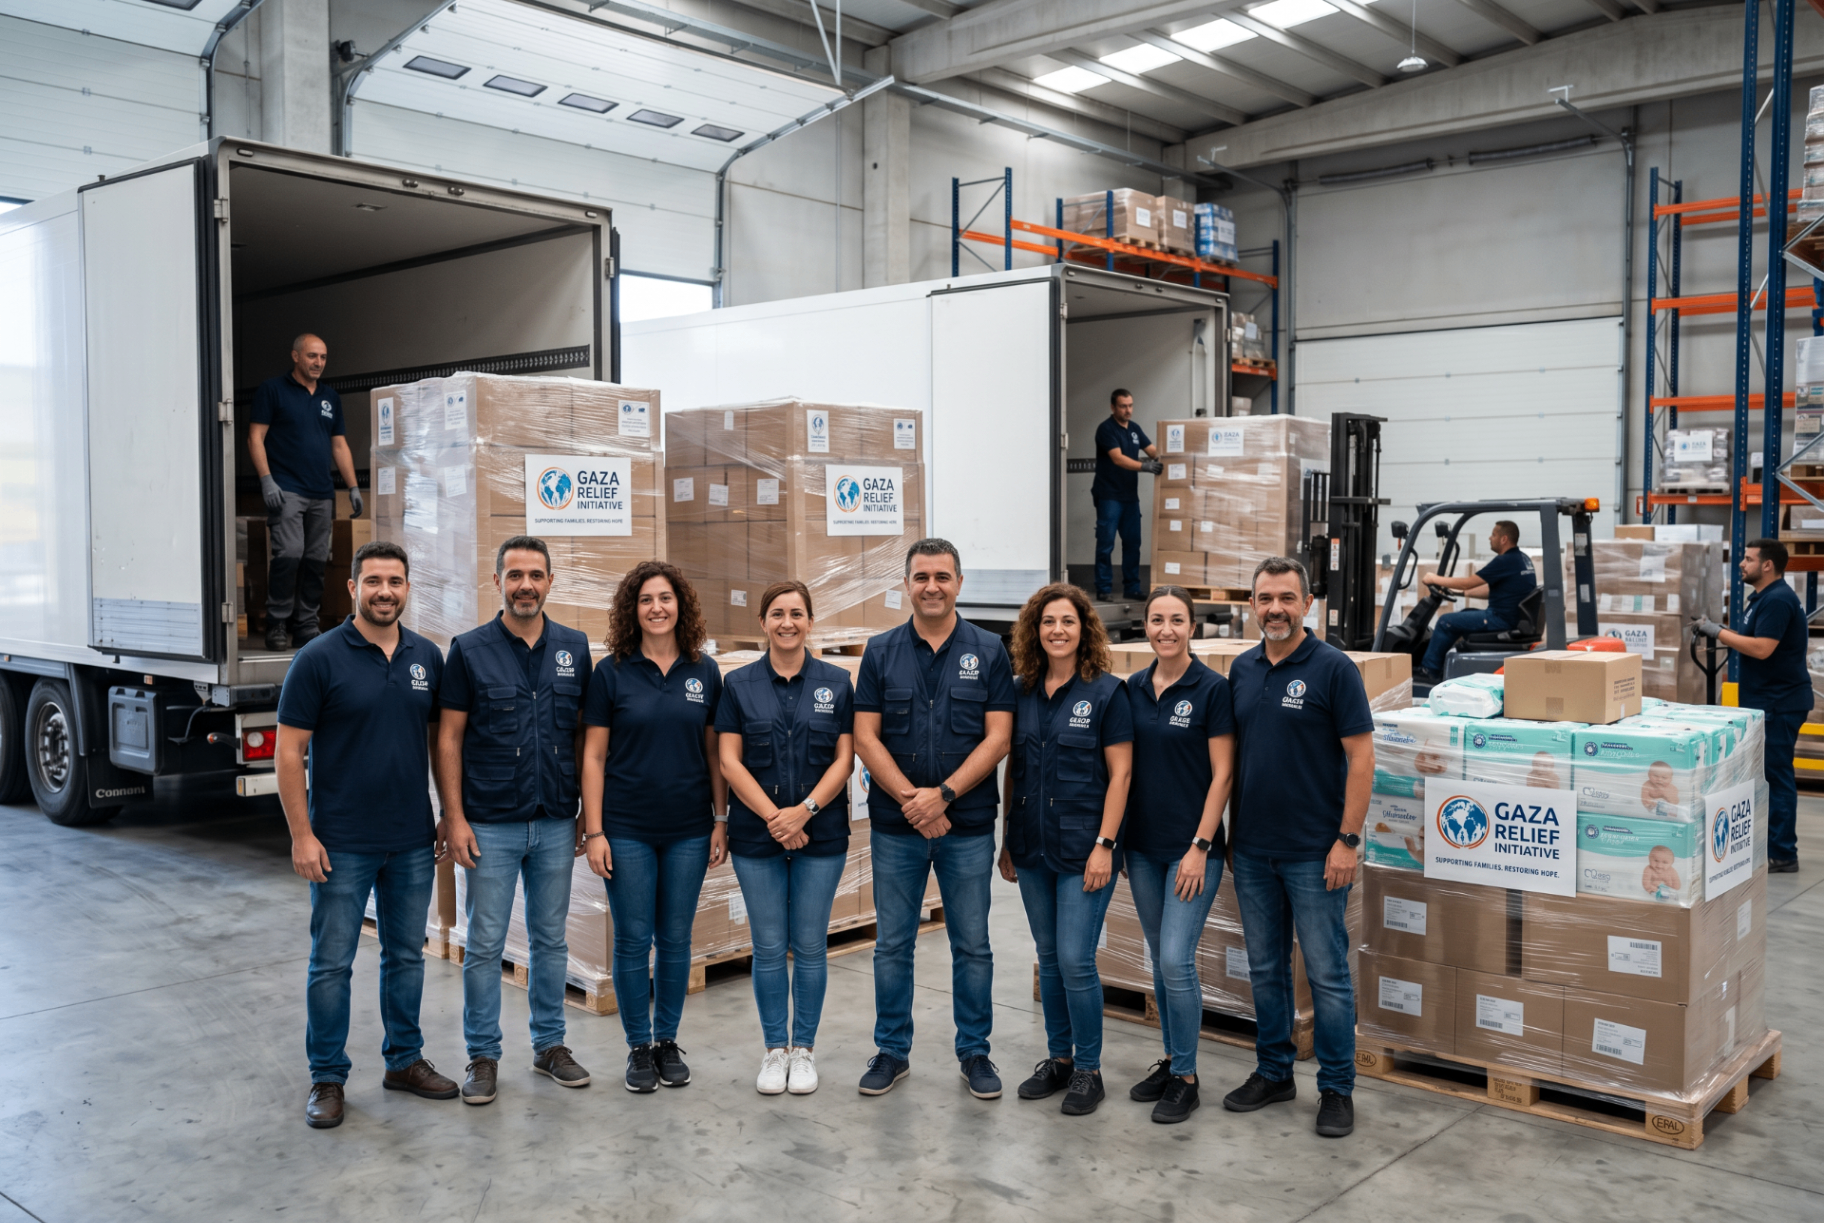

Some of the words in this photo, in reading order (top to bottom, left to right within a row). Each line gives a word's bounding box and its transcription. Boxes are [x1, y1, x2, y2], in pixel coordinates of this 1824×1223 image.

[577, 470, 620, 486] GAZA
[862, 478, 894, 491] GAZA
[577, 486, 618, 499] RELIEF
[864, 492, 894, 503] RELIEF
[577, 501, 623, 510] INITIATIVE
[863, 504, 897, 512] INITIATIVE
[1494, 802, 1559, 826] GAZA
[1731, 799, 1751, 823] GAZA
[1495, 824, 1560, 845] RELIEF
[1731, 819, 1751, 842] RELIEF
[1494, 843, 1560, 860] INITIATIVE
[1435, 856, 1472, 867] SUPPORTING
[1474, 861, 1503, 871] FAMILIES.
[1504, 865, 1539, 875] RESTORING
[1540, 870, 1560, 878] HOPE.
